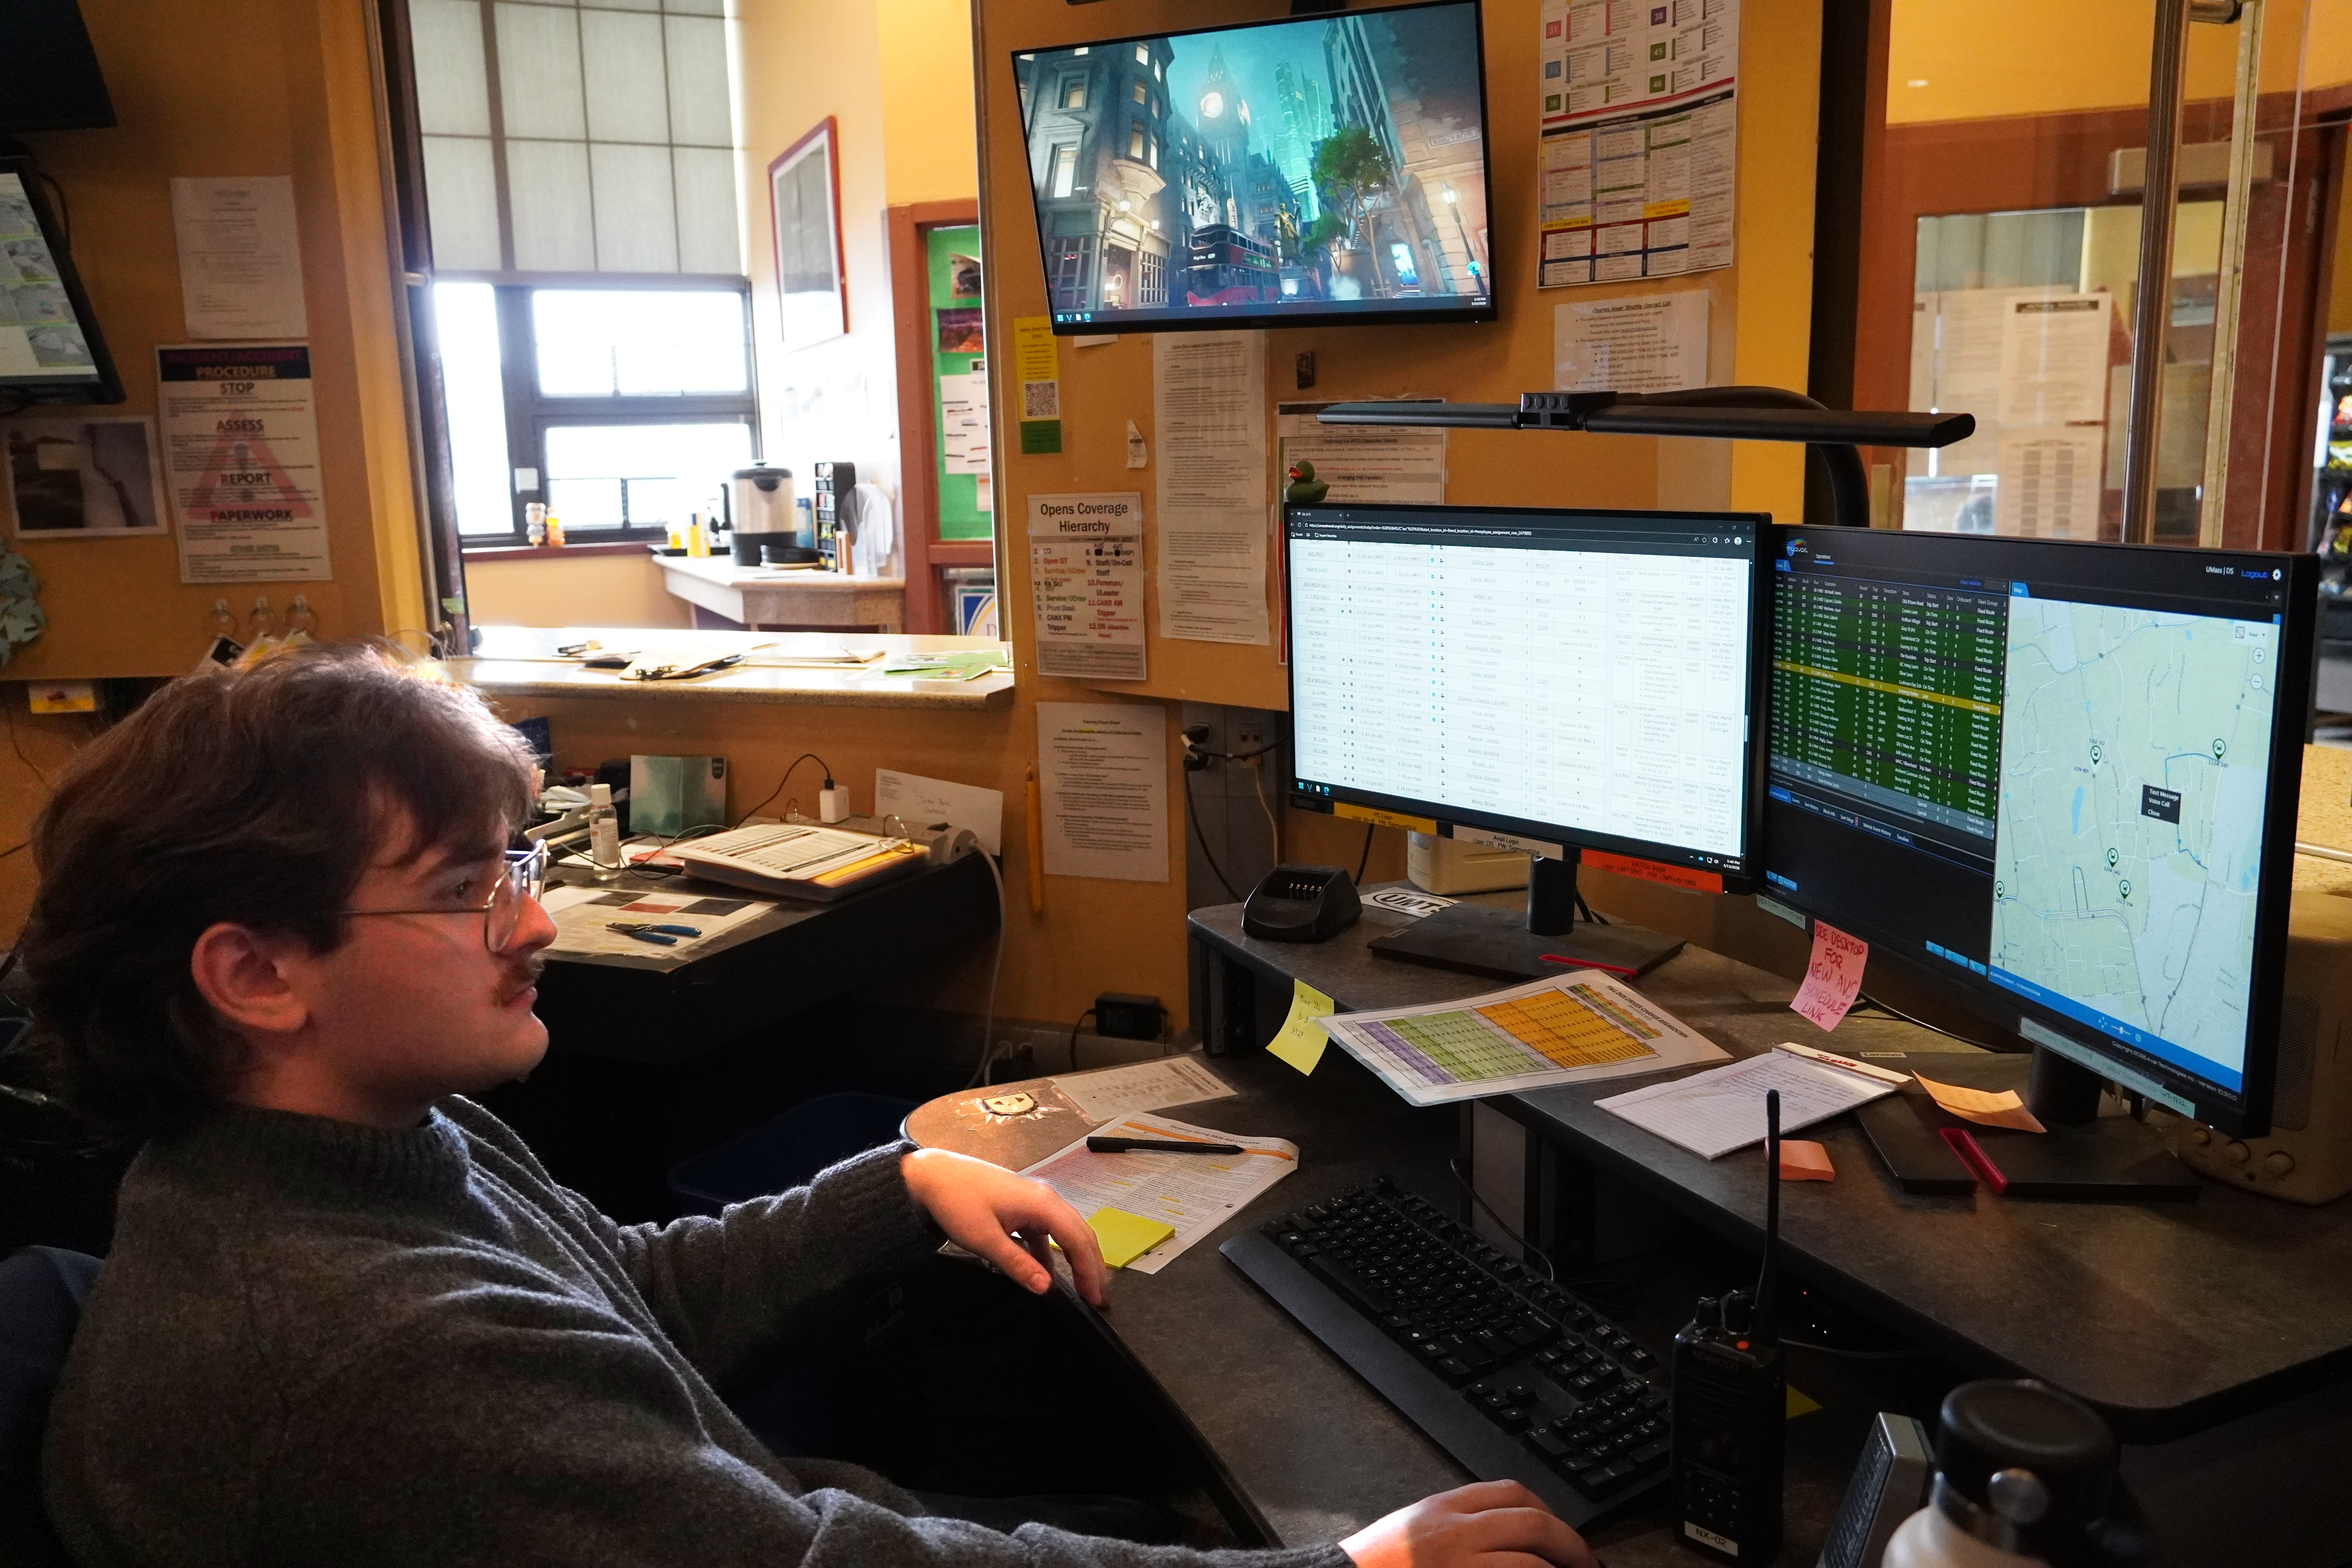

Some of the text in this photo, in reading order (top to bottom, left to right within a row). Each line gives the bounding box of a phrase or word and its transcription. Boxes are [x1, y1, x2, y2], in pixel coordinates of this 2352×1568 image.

[197, 366, 276, 378] PROCEDURE
[220, 382, 254, 394] STOP
[217, 419, 264, 432] ASSESS
[220, 473, 271, 485] REPORT
[211, 510, 293, 521] PAPERWORK
[1040, 502, 1128, 517] Opens Coverage
[1059, 520, 1110, 534] Hierarchy
[2205, 566, 2223, 574] UMass
[2241, 570, 2269, 579] Logout
[2148, 797, 2161, 806] Voice
[2160, 791, 2179, 802] Message
[2148, 809, 2160, 817] Close
[1881, 828, 1891, 837] History
[1896, 834, 1909, 842] Timeline
[1601, 862, 1659, 879] User: UMTSRO PW:
[1631, 860, 1666, 873] VATCo Avail
[1815, 924, 1865, 957] SEE DESKTOP
[1824, 947, 1844, 970] FOR
[1810, 961, 1858, 999] NEW AVS
[1804, 983, 1848, 1015] SCHEDULE
[1606, 985, 1690, 1038] FALL DRIVER CHANGE BREAKDOWN
[1801, 1003, 1827, 1022] LINK
[1298, 1013, 1309, 1024] 31-3
[1290, 1027, 1304, 1039] 3323
[2112, 1040, 2133, 1053] Copyright
[2158, 1061, 2186, 1078] Technologies
[2198, 1080, 2216, 1092] Version
[1170, 1124, 1194, 1134] Weekday
[1692, 1349, 1739, 1372] KENWOOD
[1696, 1528, 1726, 1547] NX-02
